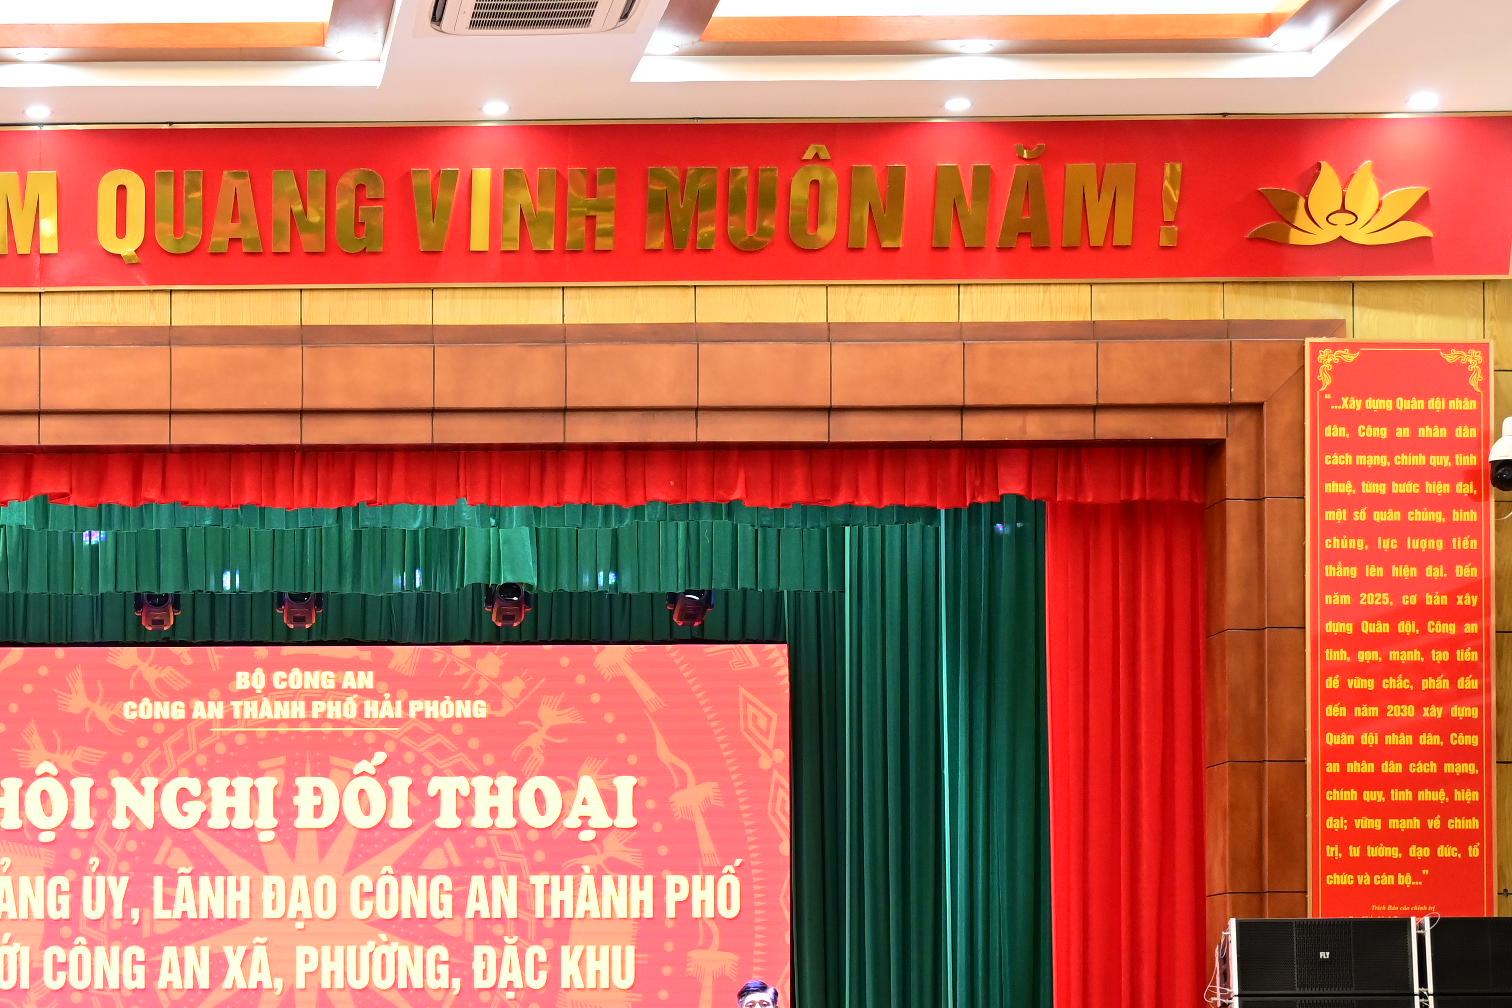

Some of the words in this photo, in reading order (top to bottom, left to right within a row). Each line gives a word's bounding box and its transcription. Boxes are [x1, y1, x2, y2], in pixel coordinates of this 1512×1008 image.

[97, 169, 386, 264] QUANG
[410, 168, 617, 252] VINH
[645, 144, 907, 252] MUÔN
[932, 143, 1138, 248] NĂM
[1325, 425, 1349, 438] dân,
[1358, 425, 1387, 438] Công
[1396, 428, 1409, 437] an
[1419, 426, 1447, 437] nhân
[1456, 426, 1476, 437] dân
[1325, 453, 1352, 465] cách
[1356, 455, 1390, 467] mạng,
[1394, 453, 1426, 465] chính
[1430, 456, 1451, 467] quy,
[1392, 481, 1419, 493] bước
[1426, 481, 1450, 495] hiện
[1456, 482, 1476, 496] đại,
[1325, 592, 1351, 604] năm
[1360, 593, 1393, 606] 2025,
[1402, 594, 1416, 605] cơ
[1457, 593, 1477, 606] xây
[1326, 621, 1353, 635] dựng
[1361, 621, 1389, 634] Quân
[1398, 621, 1419, 635] đội,
[1428, 621, 1456, 634] Công
[1464, 624, 1478, 633] an
[236, 668, 265, 693] BỘ
[273, 668, 334, 688] CÔNG
[342, 671, 373, 688] AN
[123, 698, 185, 719] CÔNG
[192, 701, 223, 718] AN
[231, 695, 305, 718] THÀNH
[312, 695, 357, 718] PHỐ
[364, 694, 401, 718] HẢI
[409, 696, 486, 718] PHÒNG
[1326, 703, 1346, 716] đến
[1355, 704, 1378, 716] năm
[1387, 705, 1414, 717] 2030
[1423, 705, 1443, 718] xây
[1451, 705, 1478, 719] dựng
[1326, 733, 1354, 746] Quân
[1361, 733, 1378, 747] đội
[1385, 733, 1412, 744] nhân
[1420, 733, 1443, 746] dân,
[1450, 733, 1478, 746] Công
[111, 777, 278, 841] NGHỊ
[293, 752, 412, 828] ĐỐI
[428, 776, 637, 840] THOẠI
[83, 857, 139, 924] ỦY,
[153, 867, 249, 918] LÃNH
[262, 875, 336, 928] ĐẠO
[351, 866, 452, 919] CÔNG
[465, 876, 517, 918] AN
[530, 866, 653, 918] THÀNH
[666, 859, 742, 918] PHỐ
[44, 937, 145, 989] CÔNG
[158, 946, 209, 988] AN
[223, 937, 282, 994] XÃ,
[296, 934, 460, 994] PHƯỜNG,
[472, 936, 546, 998] ĐẶC
[561, 946, 634, 988] KHU
